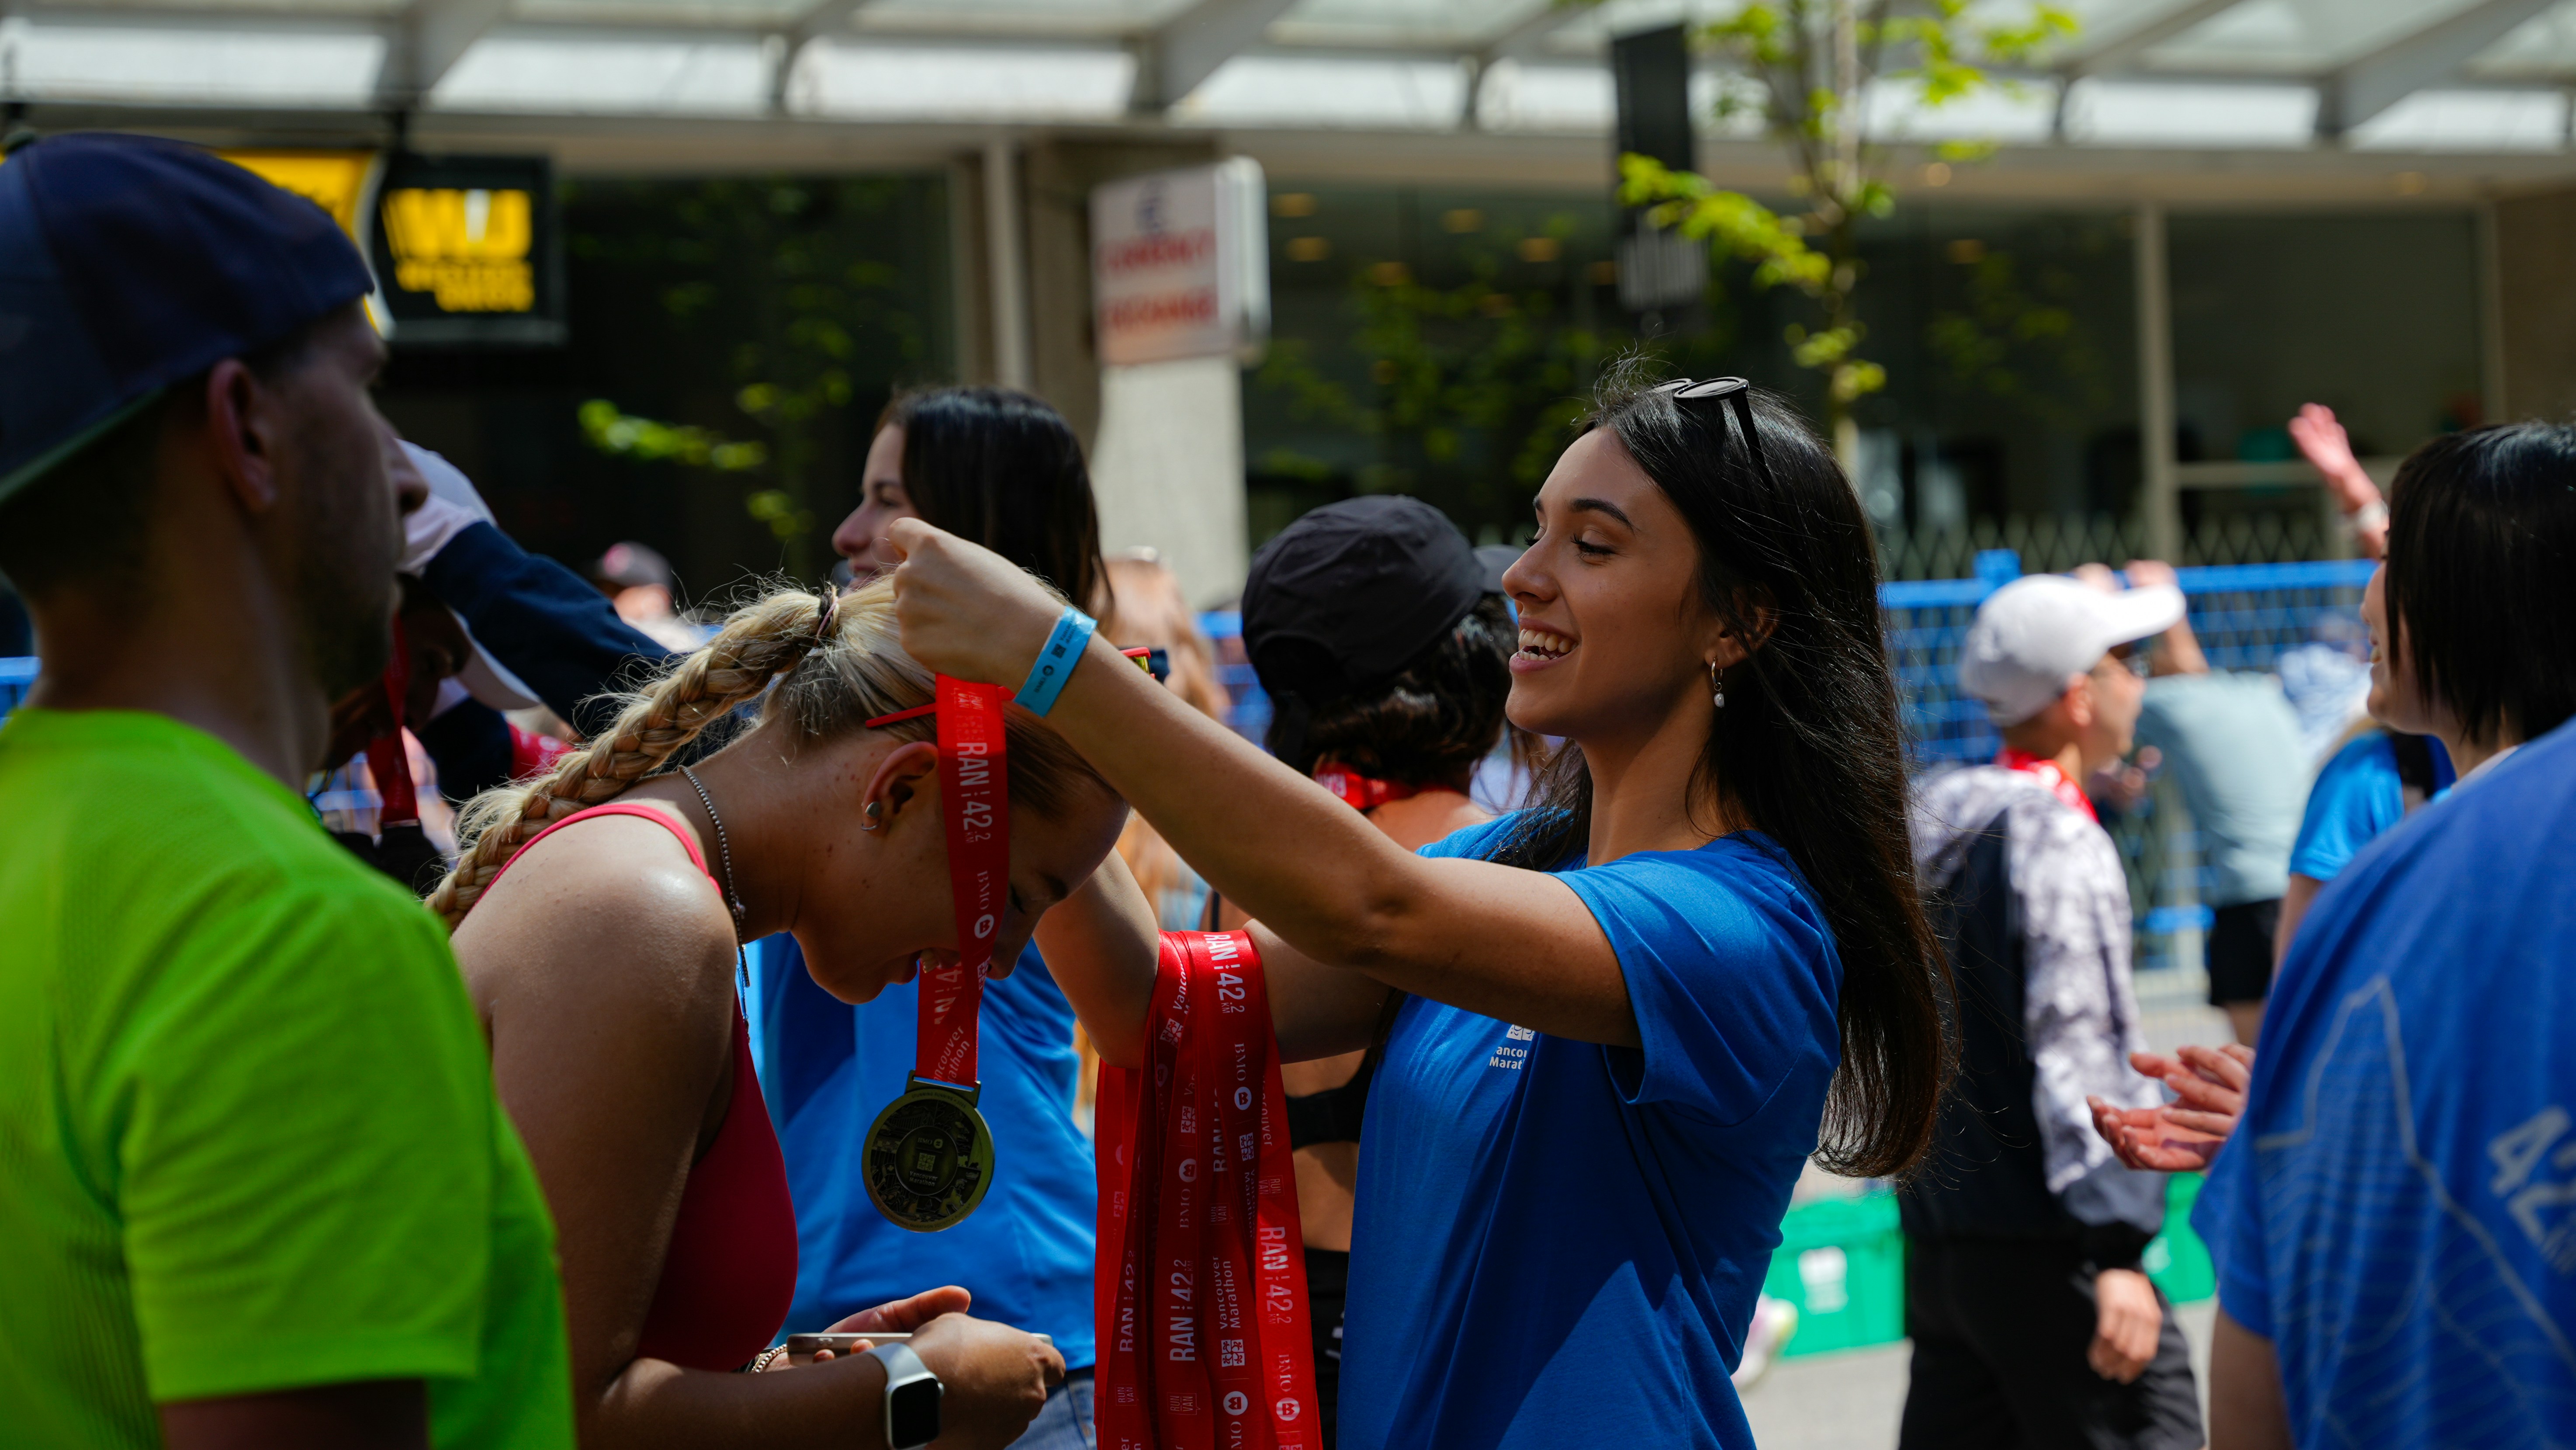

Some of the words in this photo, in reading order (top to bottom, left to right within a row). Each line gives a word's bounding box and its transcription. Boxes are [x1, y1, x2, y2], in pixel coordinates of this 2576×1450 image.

[956, 742, 990, 786] RAN
[976, 870, 990, 910] BMO
[1204, 935, 1238, 961] RAN
[1221, 1002, 1230, 1013] KM
[1234, 1042, 1246, 1082] BMO
[1489, 1056, 1525, 1070] Marat
[1270, 1178, 1281, 1194] RUN
[1180, 1188, 1191, 1228] BMO
[1218, 1206, 1227, 1222] VAN
[1260, 1227, 1289, 1270] RAN
[1213, 1256, 1228, 1330] Vancouver
[1223, 1261, 1241, 1328] Marathon
[1119, 1308, 1133, 1352] RAN
[1170, 1317, 1195, 1361] RAN
[1278, 1354, 1292, 1392] BMO
[1117, 1387, 1126, 1403] RUN
[1170, 1395, 1180, 1412] RUN
[1182, 1396, 1193, 1412] VAN
[1230, 1421, 1242, 1450] MO
